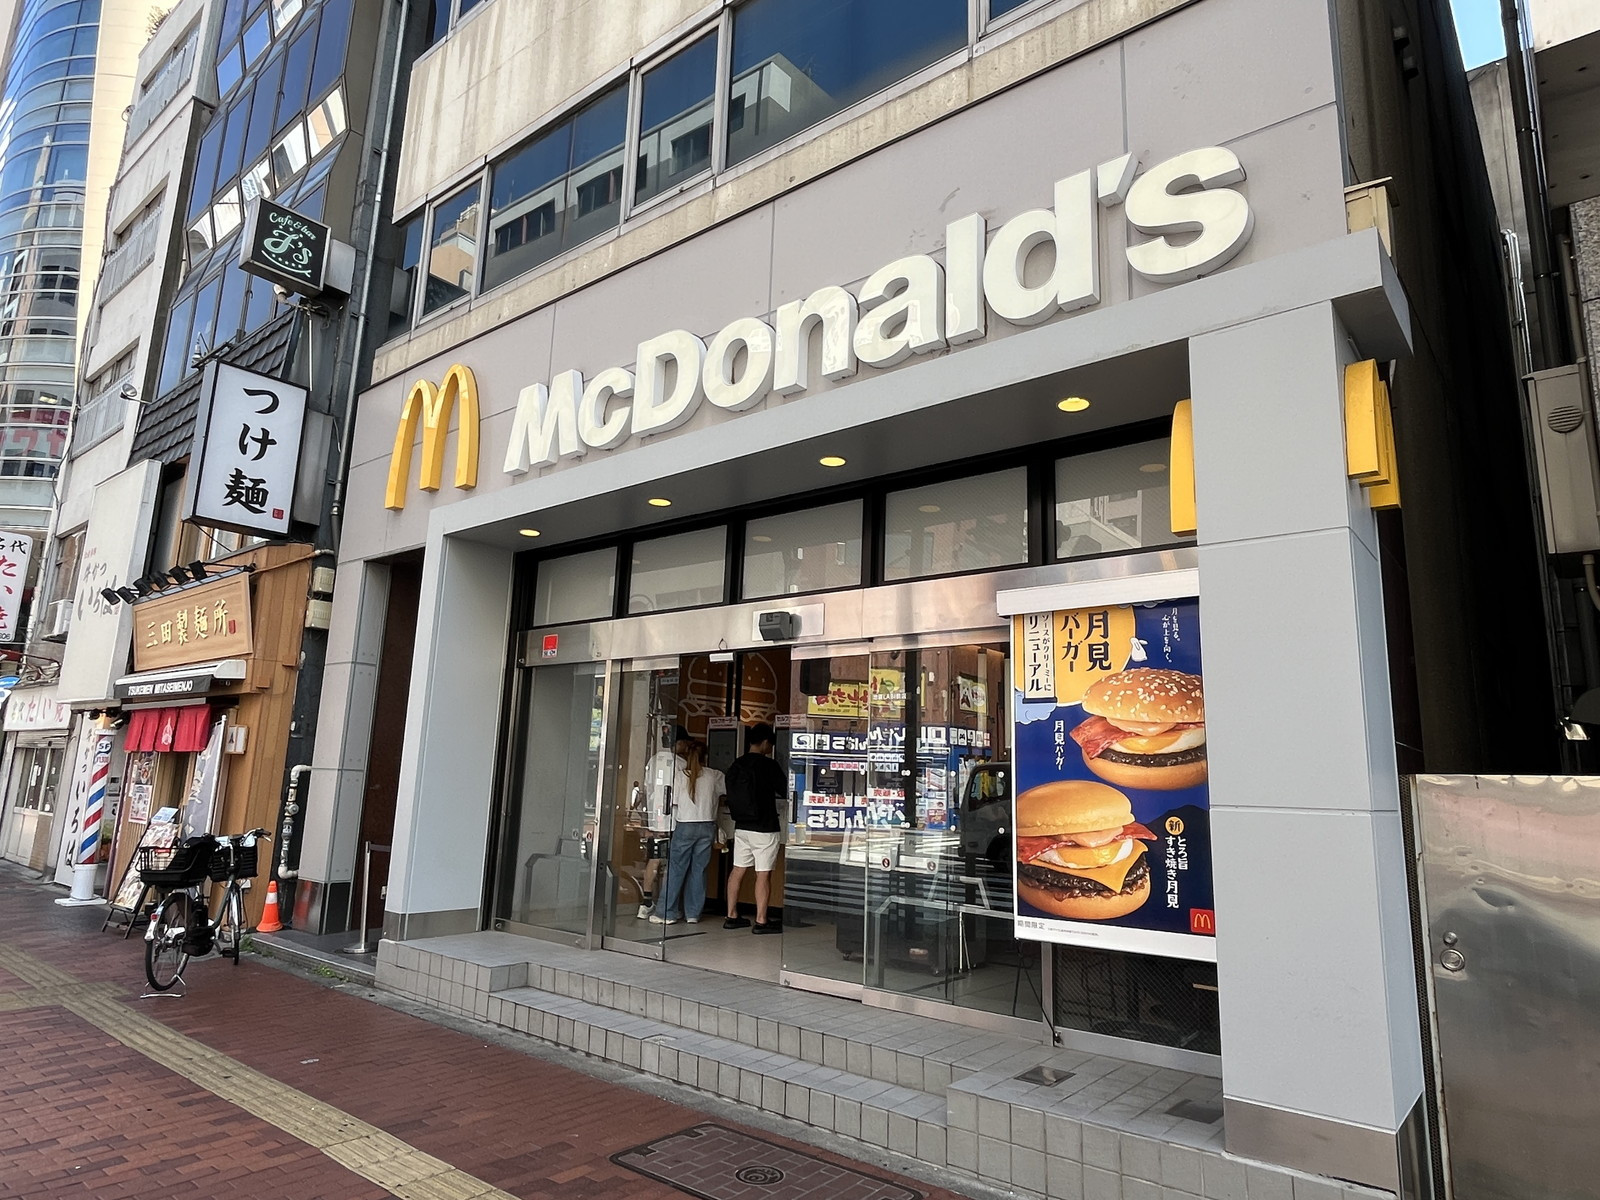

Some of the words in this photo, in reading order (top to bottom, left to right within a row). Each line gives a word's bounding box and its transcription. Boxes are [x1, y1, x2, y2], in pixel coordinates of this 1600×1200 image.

[503, 146, 1255, 475] McDonald's
[222, 388, 280, 514] つけ麺
[146, 599, 229, 648] 三田製麺所
[1029, 615, 1043, 692] リニューアル
[1042, 614, 1052, 691] ソースがクリーミーに
[1061, 612, 1083, 672] バーガー
[1084, 610, 1112, 671] 月見
[128, 684, 154, 696] TSUKEMEN
[1054, 720, 1065, 770] 月見バーガー
[1165, 835, 1179, 908] すき焼き月見
[1177, 836, 1188, 870] とろ旨
